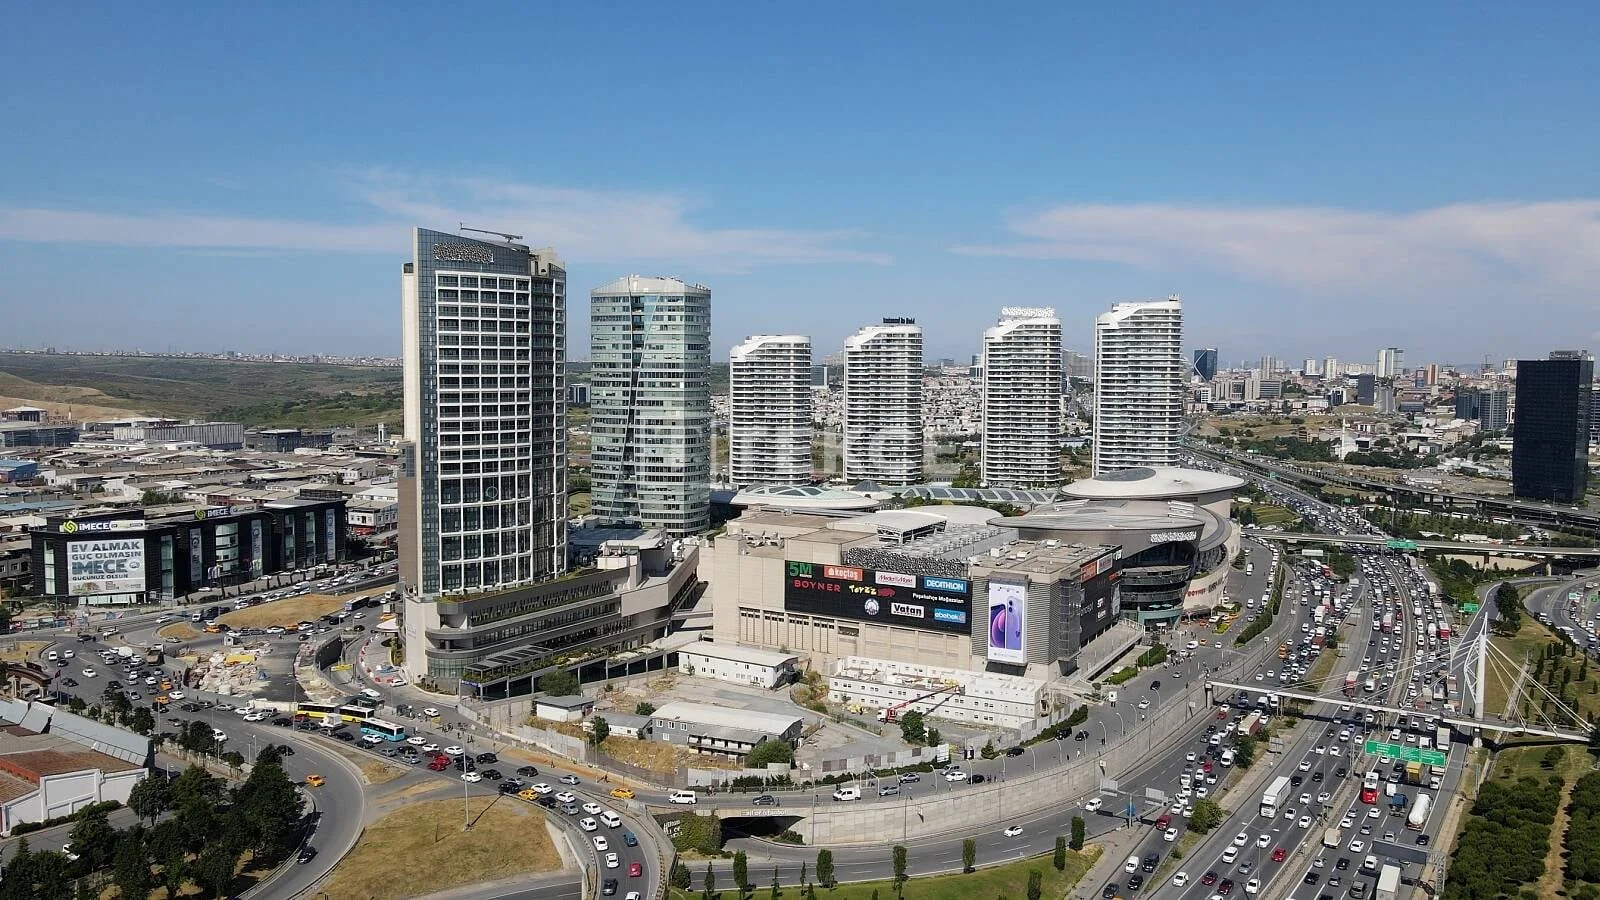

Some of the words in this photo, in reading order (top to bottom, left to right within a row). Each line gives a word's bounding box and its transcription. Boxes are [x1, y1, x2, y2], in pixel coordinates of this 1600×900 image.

[71, 544, 88, 552] EV
[92, 542, 140, 552] ALMAK
[789, 562, 812, 576] 5M
[794, 580, 841, 592] BOYNER
[926, 579, 964, 591] DECATHLON
[893, 604, 922, 616] Vatan
